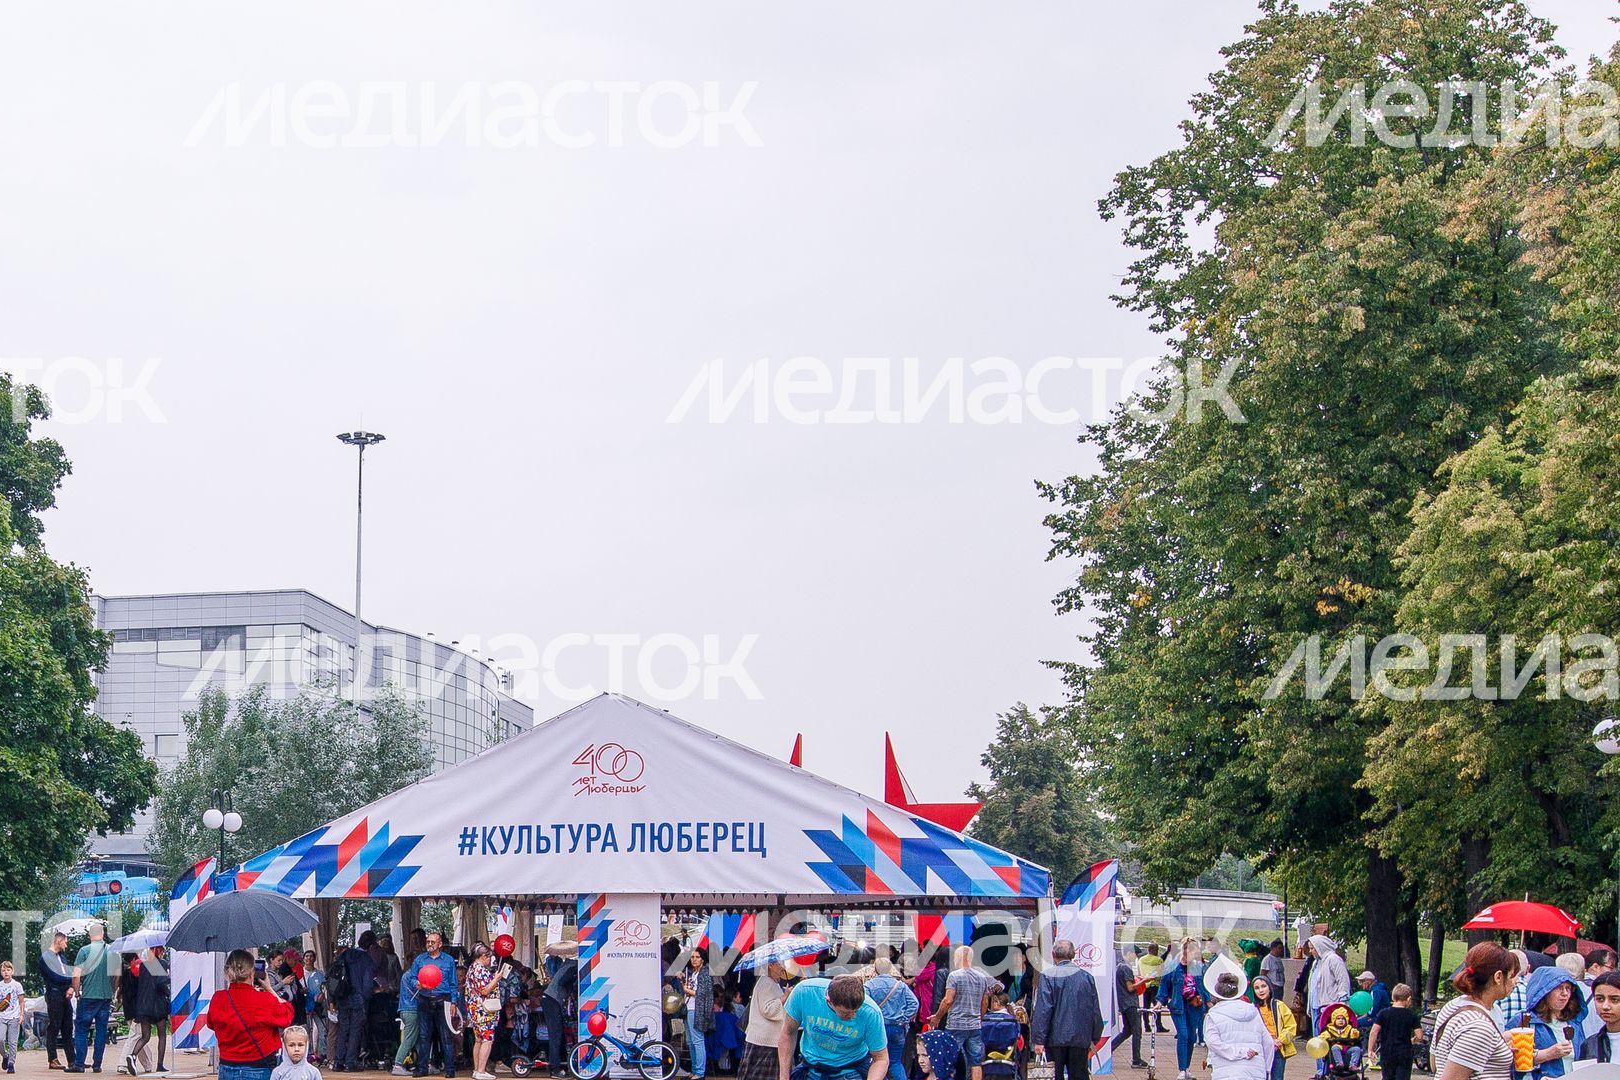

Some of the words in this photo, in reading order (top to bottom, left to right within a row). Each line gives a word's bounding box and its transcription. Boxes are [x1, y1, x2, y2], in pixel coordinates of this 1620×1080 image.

[572, 742, 644, 783] 400
[458, 823, 619, 856] #КУЛЬТУРА
[627, 822, 767, 858] ЛЮБЕРЕЦ
